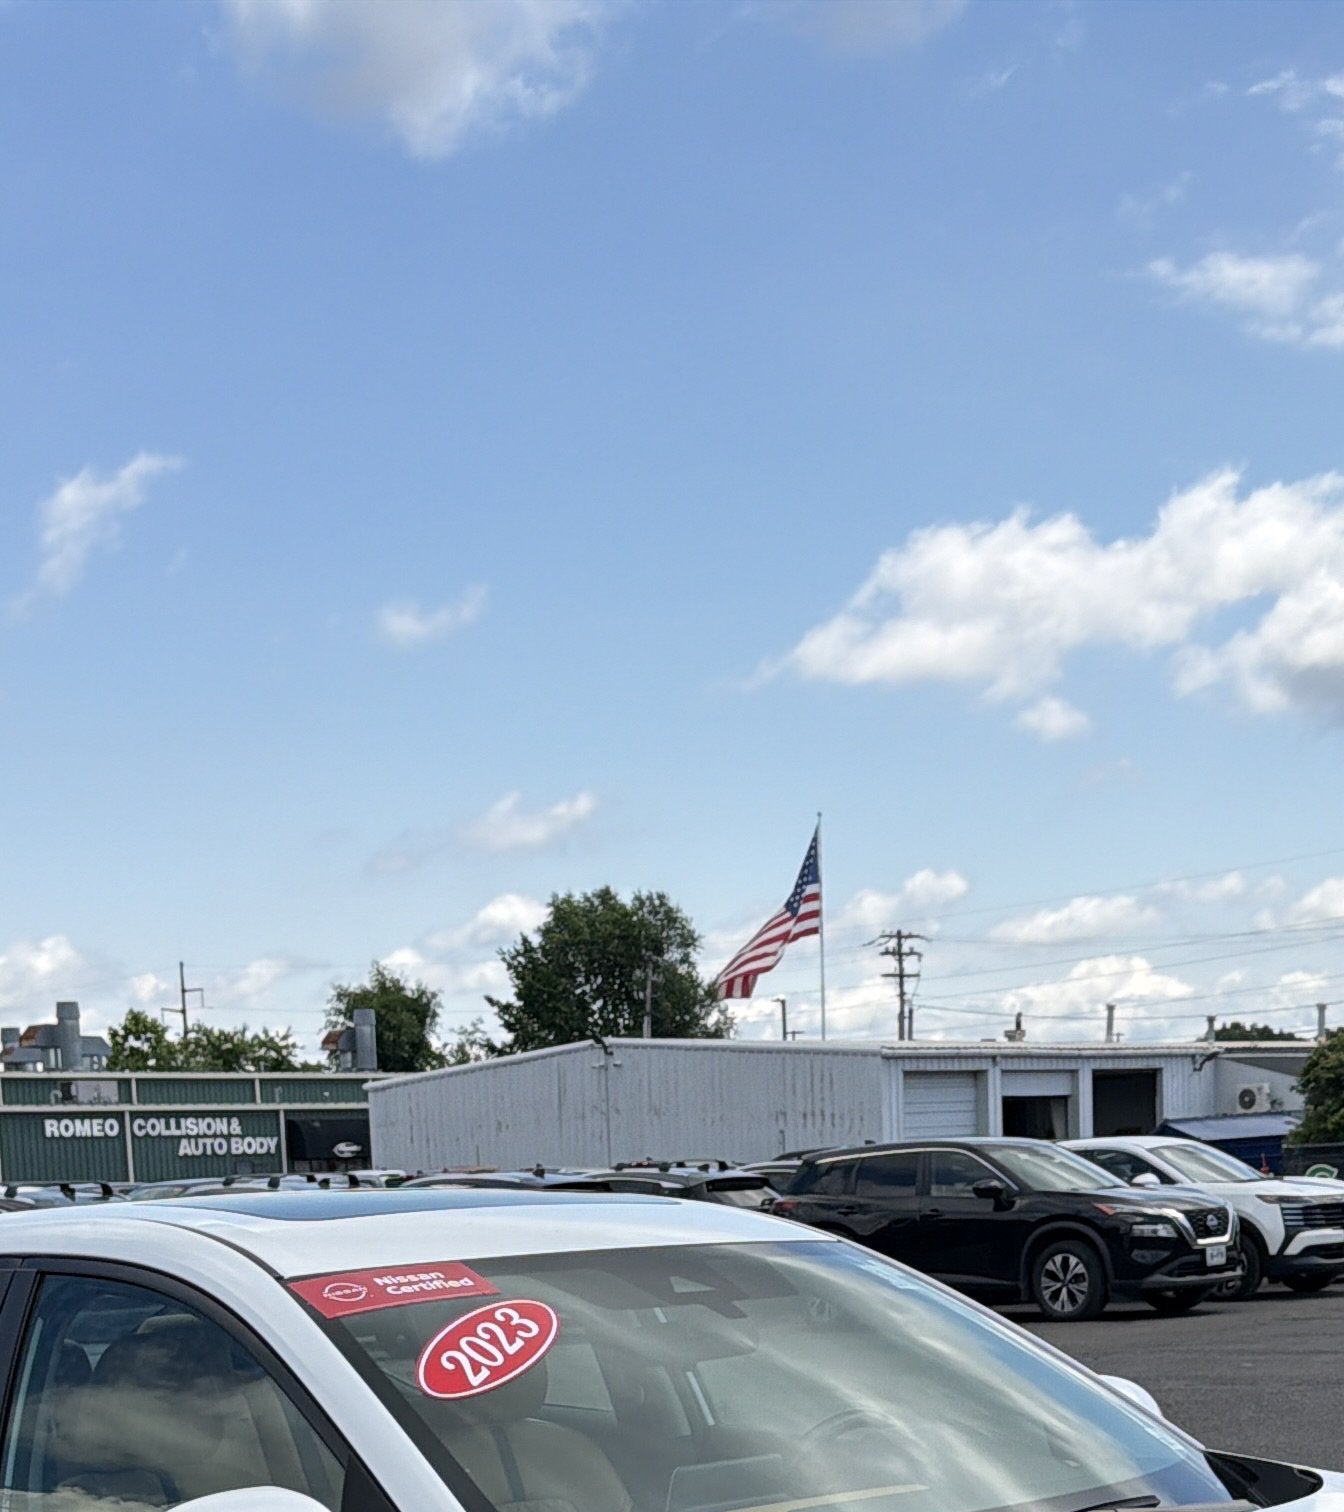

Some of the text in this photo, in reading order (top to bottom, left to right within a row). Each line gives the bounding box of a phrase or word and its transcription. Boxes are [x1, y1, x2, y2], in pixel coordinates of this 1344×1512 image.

[44, 1117, 243, 1138] ROMEO COLLISION &
[178, 1136, 278, 1157] AUTO BODY
[372, 1270, 445, 1287] Nissan
[385, 1276, 475, 1295] Certified
[440, 1307, 540, 1387] 2023
